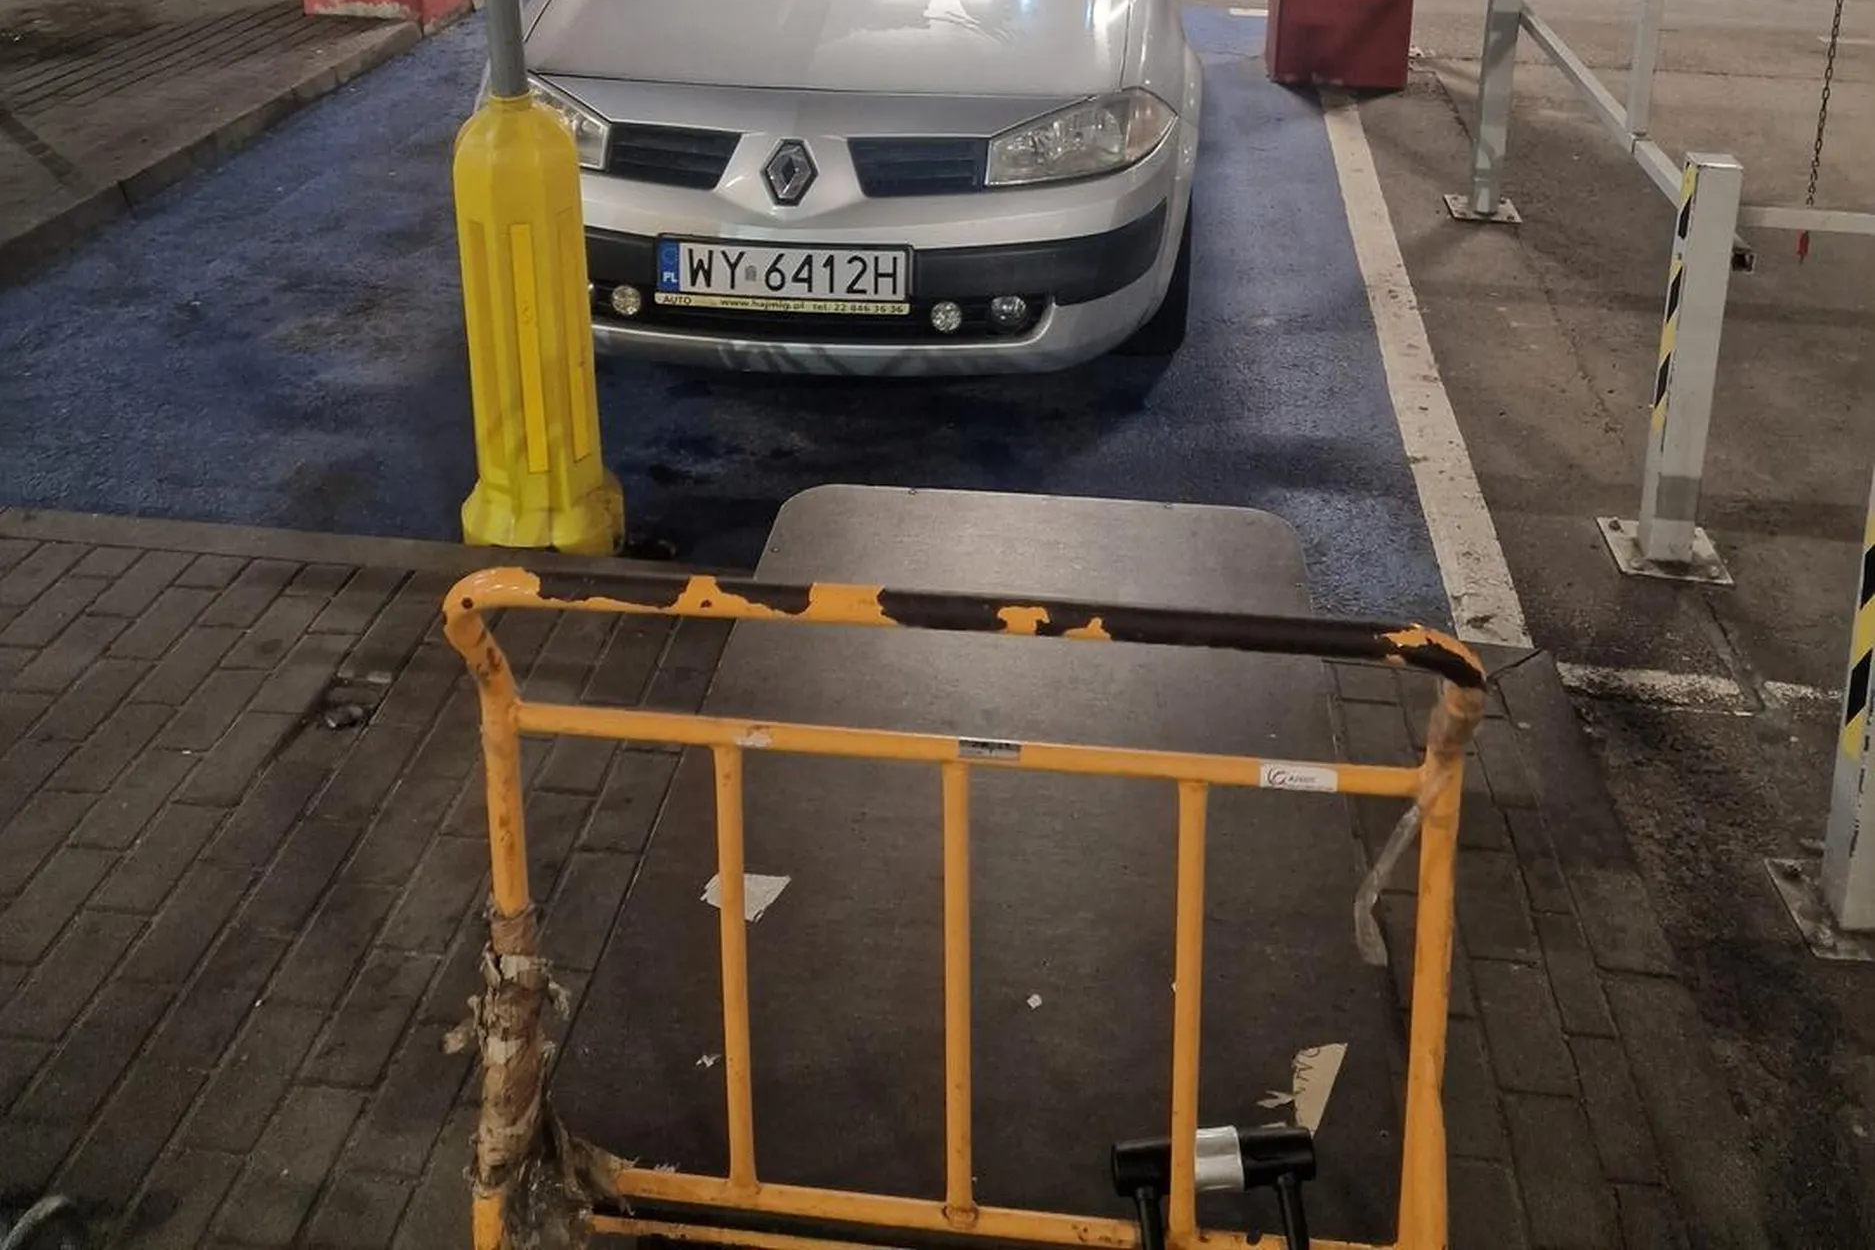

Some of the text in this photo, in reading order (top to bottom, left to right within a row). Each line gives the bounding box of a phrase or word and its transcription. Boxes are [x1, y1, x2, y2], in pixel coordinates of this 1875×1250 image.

[662, 271, 678, 283] PL
[688, 248, 898, 295] WY 6412H
[663, 295, 692, 305] AUTO
